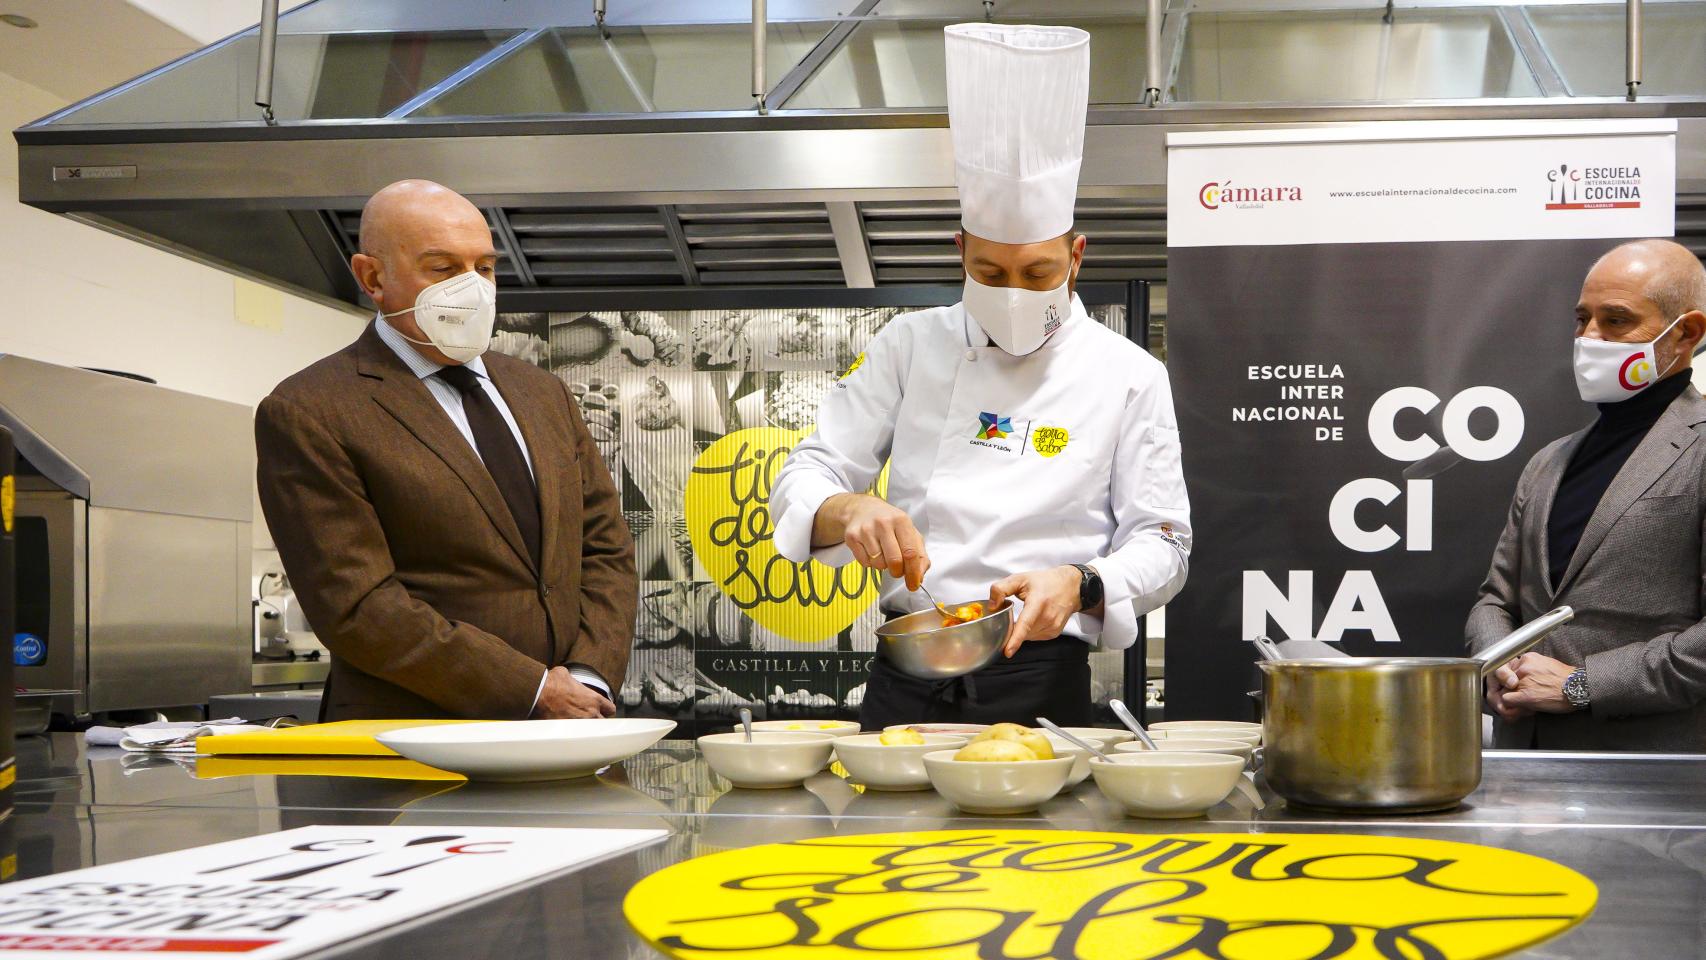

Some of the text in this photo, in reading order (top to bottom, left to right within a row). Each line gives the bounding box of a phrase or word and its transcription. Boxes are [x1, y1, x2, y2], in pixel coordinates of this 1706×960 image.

[1584, 167, 1641, 179] ESCUELA
[1199, 180, 1303, 210] Cámara
[1329, 187, 1518, 198] www.escuelainternacionaldecocina.com
[1584, 186, 1641, 200] COCINA
[1247, 364, 1345, 380] ESCUELA
[1280, 385, 1345, 400] INTER
[1231, 406, 1345, 422] NACIONAL
[1367, 385, 1525, 462] CO
[1315, 426, 1344, 441] DE
[969, 439, 995, 449] CASTILLA
[1328, 476, 1433, 553] CI
[1241, 569, 1401, 643] NA
[712, 658, 812, 673] CASTILLA
[818, 659, 832, 672] Y
[0, 908, 311, 932] OCINA
